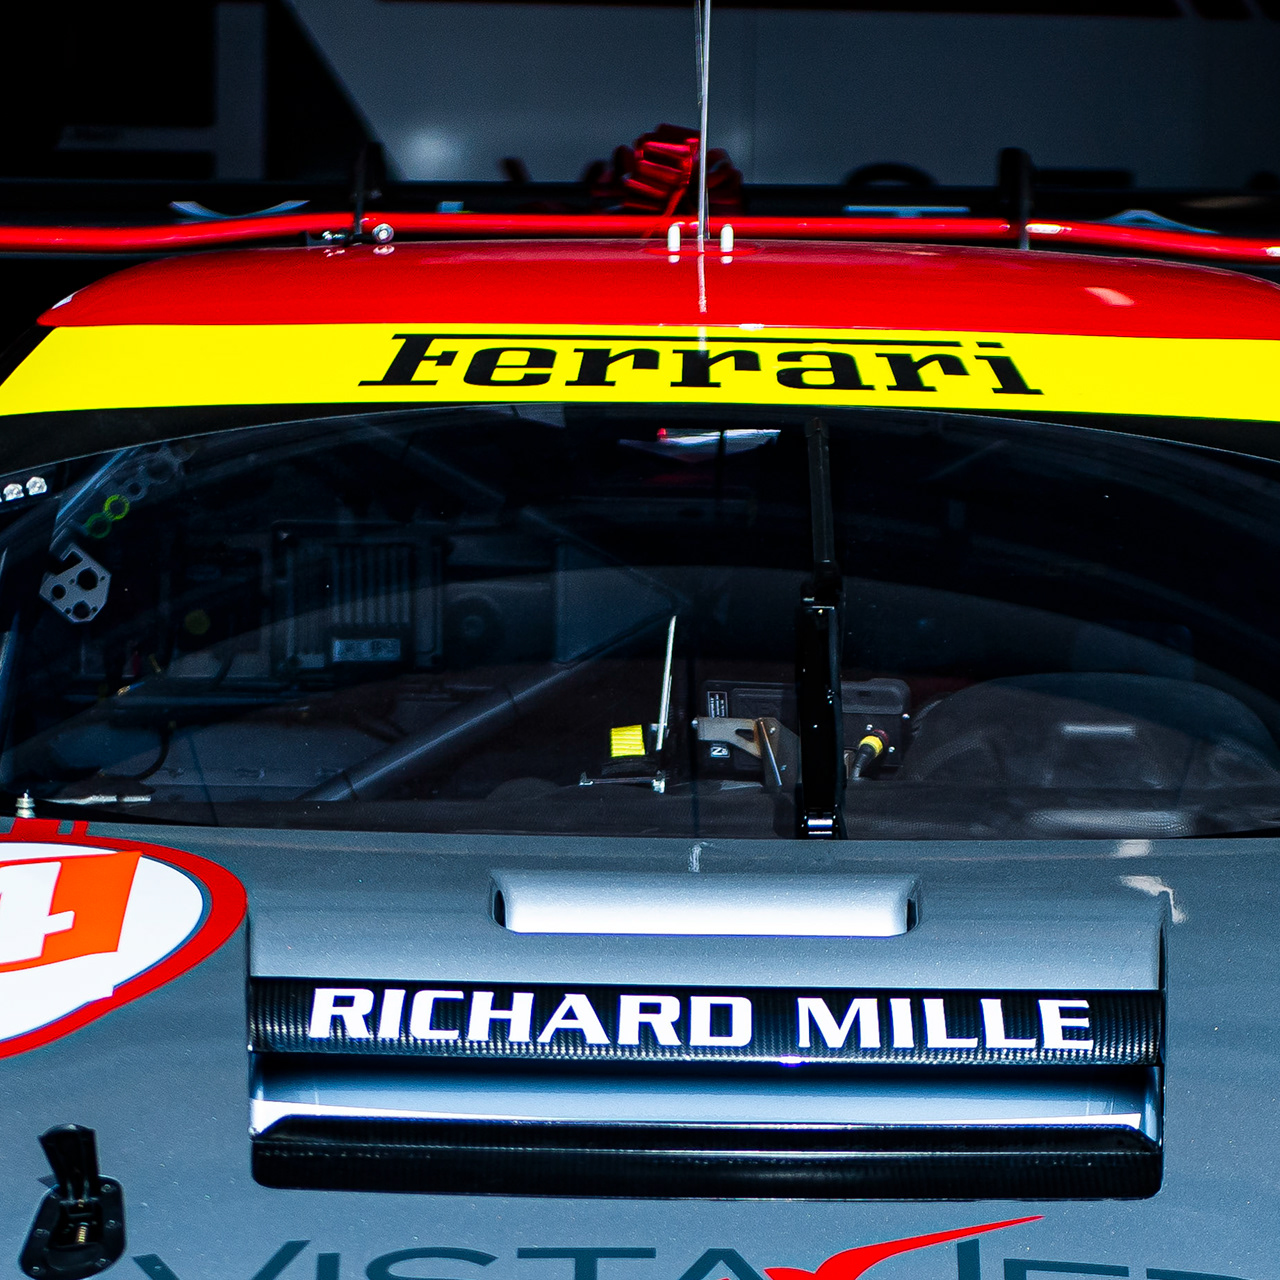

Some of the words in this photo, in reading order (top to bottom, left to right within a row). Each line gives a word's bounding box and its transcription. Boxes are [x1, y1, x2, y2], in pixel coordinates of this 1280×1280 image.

[358, 333, 1044, 396] Ferrari
[309, 988, 753, 1047] RICHARD
[797, 997, 1094, 1051] MILLE
